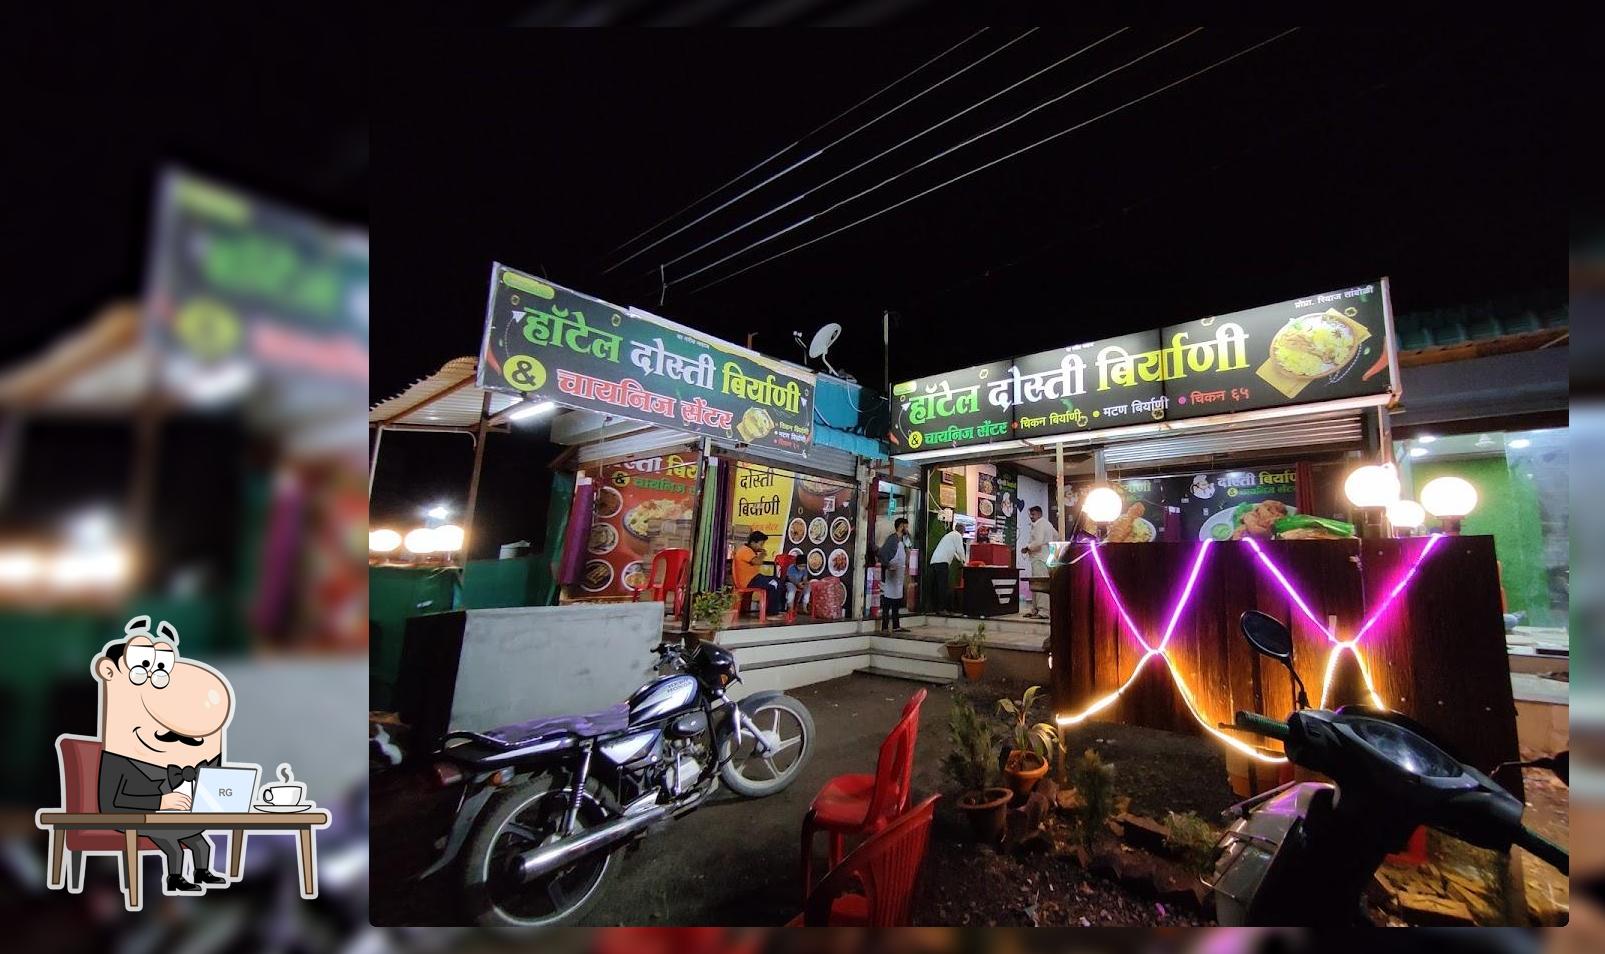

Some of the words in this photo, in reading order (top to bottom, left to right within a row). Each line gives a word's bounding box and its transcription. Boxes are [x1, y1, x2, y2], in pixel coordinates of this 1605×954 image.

[523, 304, 624, 363] हॉटेल
[629, 338, 716, 390] दोस्ती
[721, 361, 802, 414] बिर्याणी
[909, 380, 981, 425] हॉटेल
[987, 353, 1087, 412] दोस्ती
[1095, 322, 1250, 392] बिर्याणी
[511, 360, 537, 386] &
[556, 368, 677, 419] चायनिज
[680, 396, 734, 430] सेंटर
[1190, 390, 1226, 405] चिकन
[1231, 388, 1250, 401] ६५
[1103, 405, 1128, 417] मटण
[1131, 396, 1169, 414] बिर्याणी
[1020, 416, 1046, 429] चिकन
[1049, 409, 1082, 424] बिर्याणी
[911, 432, 920, 446] &
[925, 425, 974, 444] चायनिज
[977, 420, 1008, 437] सेंटर
[740, 468, 774, 489] दोस्ती
[738, 495, 780, 516] बिर्याणी
